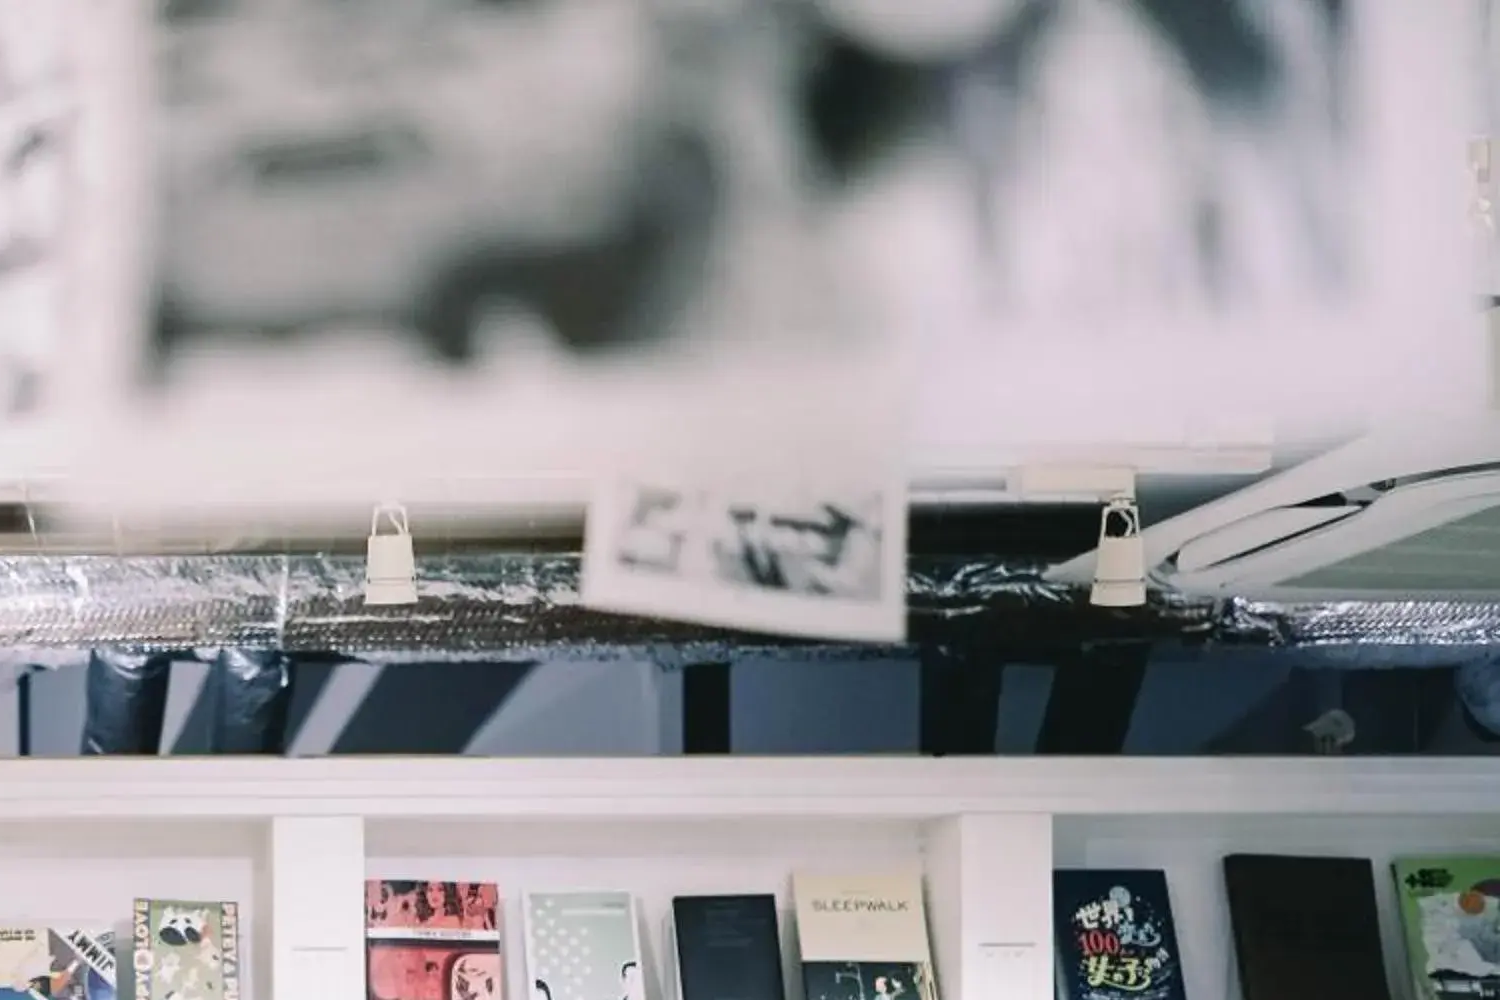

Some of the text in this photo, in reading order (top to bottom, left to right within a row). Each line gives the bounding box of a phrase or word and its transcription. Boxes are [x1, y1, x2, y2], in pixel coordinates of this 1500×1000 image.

[134, 901, 151, 946] LOVE
[812, 898, 909, 912] SLEEPWALK
[65, 928, 115, 974] JIMMY
